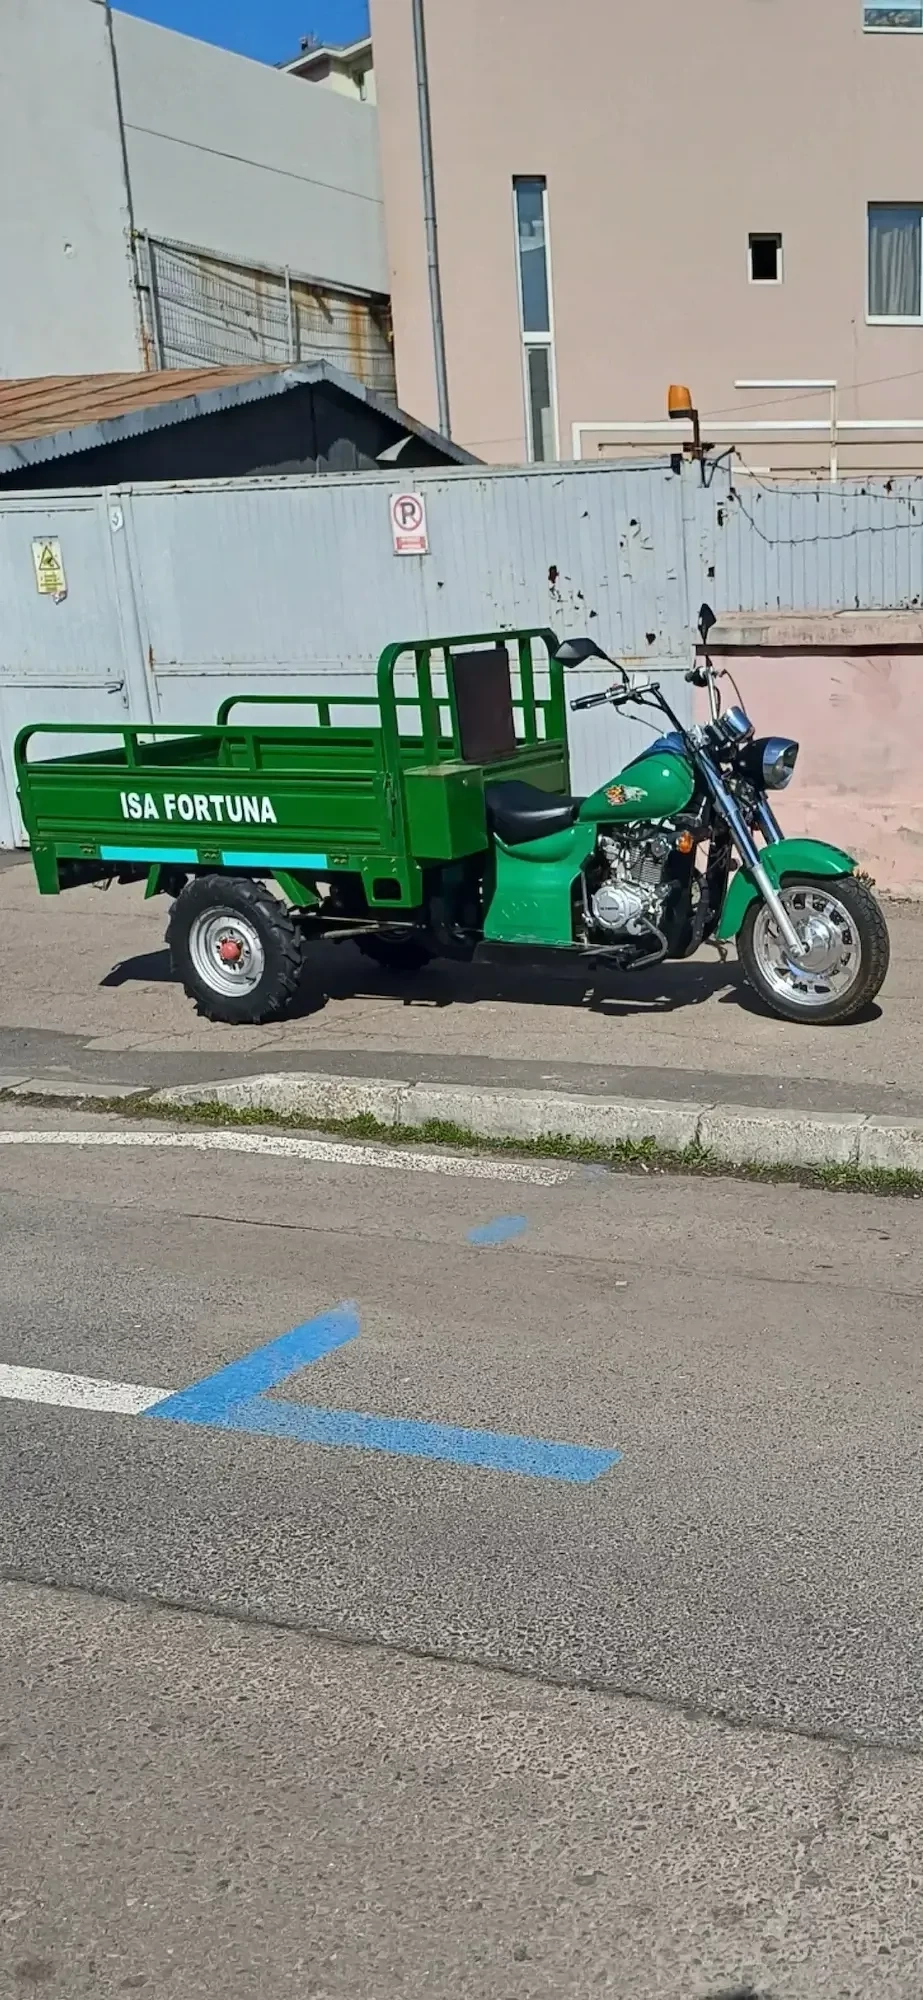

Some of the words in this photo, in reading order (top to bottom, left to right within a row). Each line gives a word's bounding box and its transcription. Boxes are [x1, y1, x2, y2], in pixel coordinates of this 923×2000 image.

[400, 502, 416, 524] P
[120, 791, 160, 819] ISA
[163, 793, 278, 823] FORTUNA
